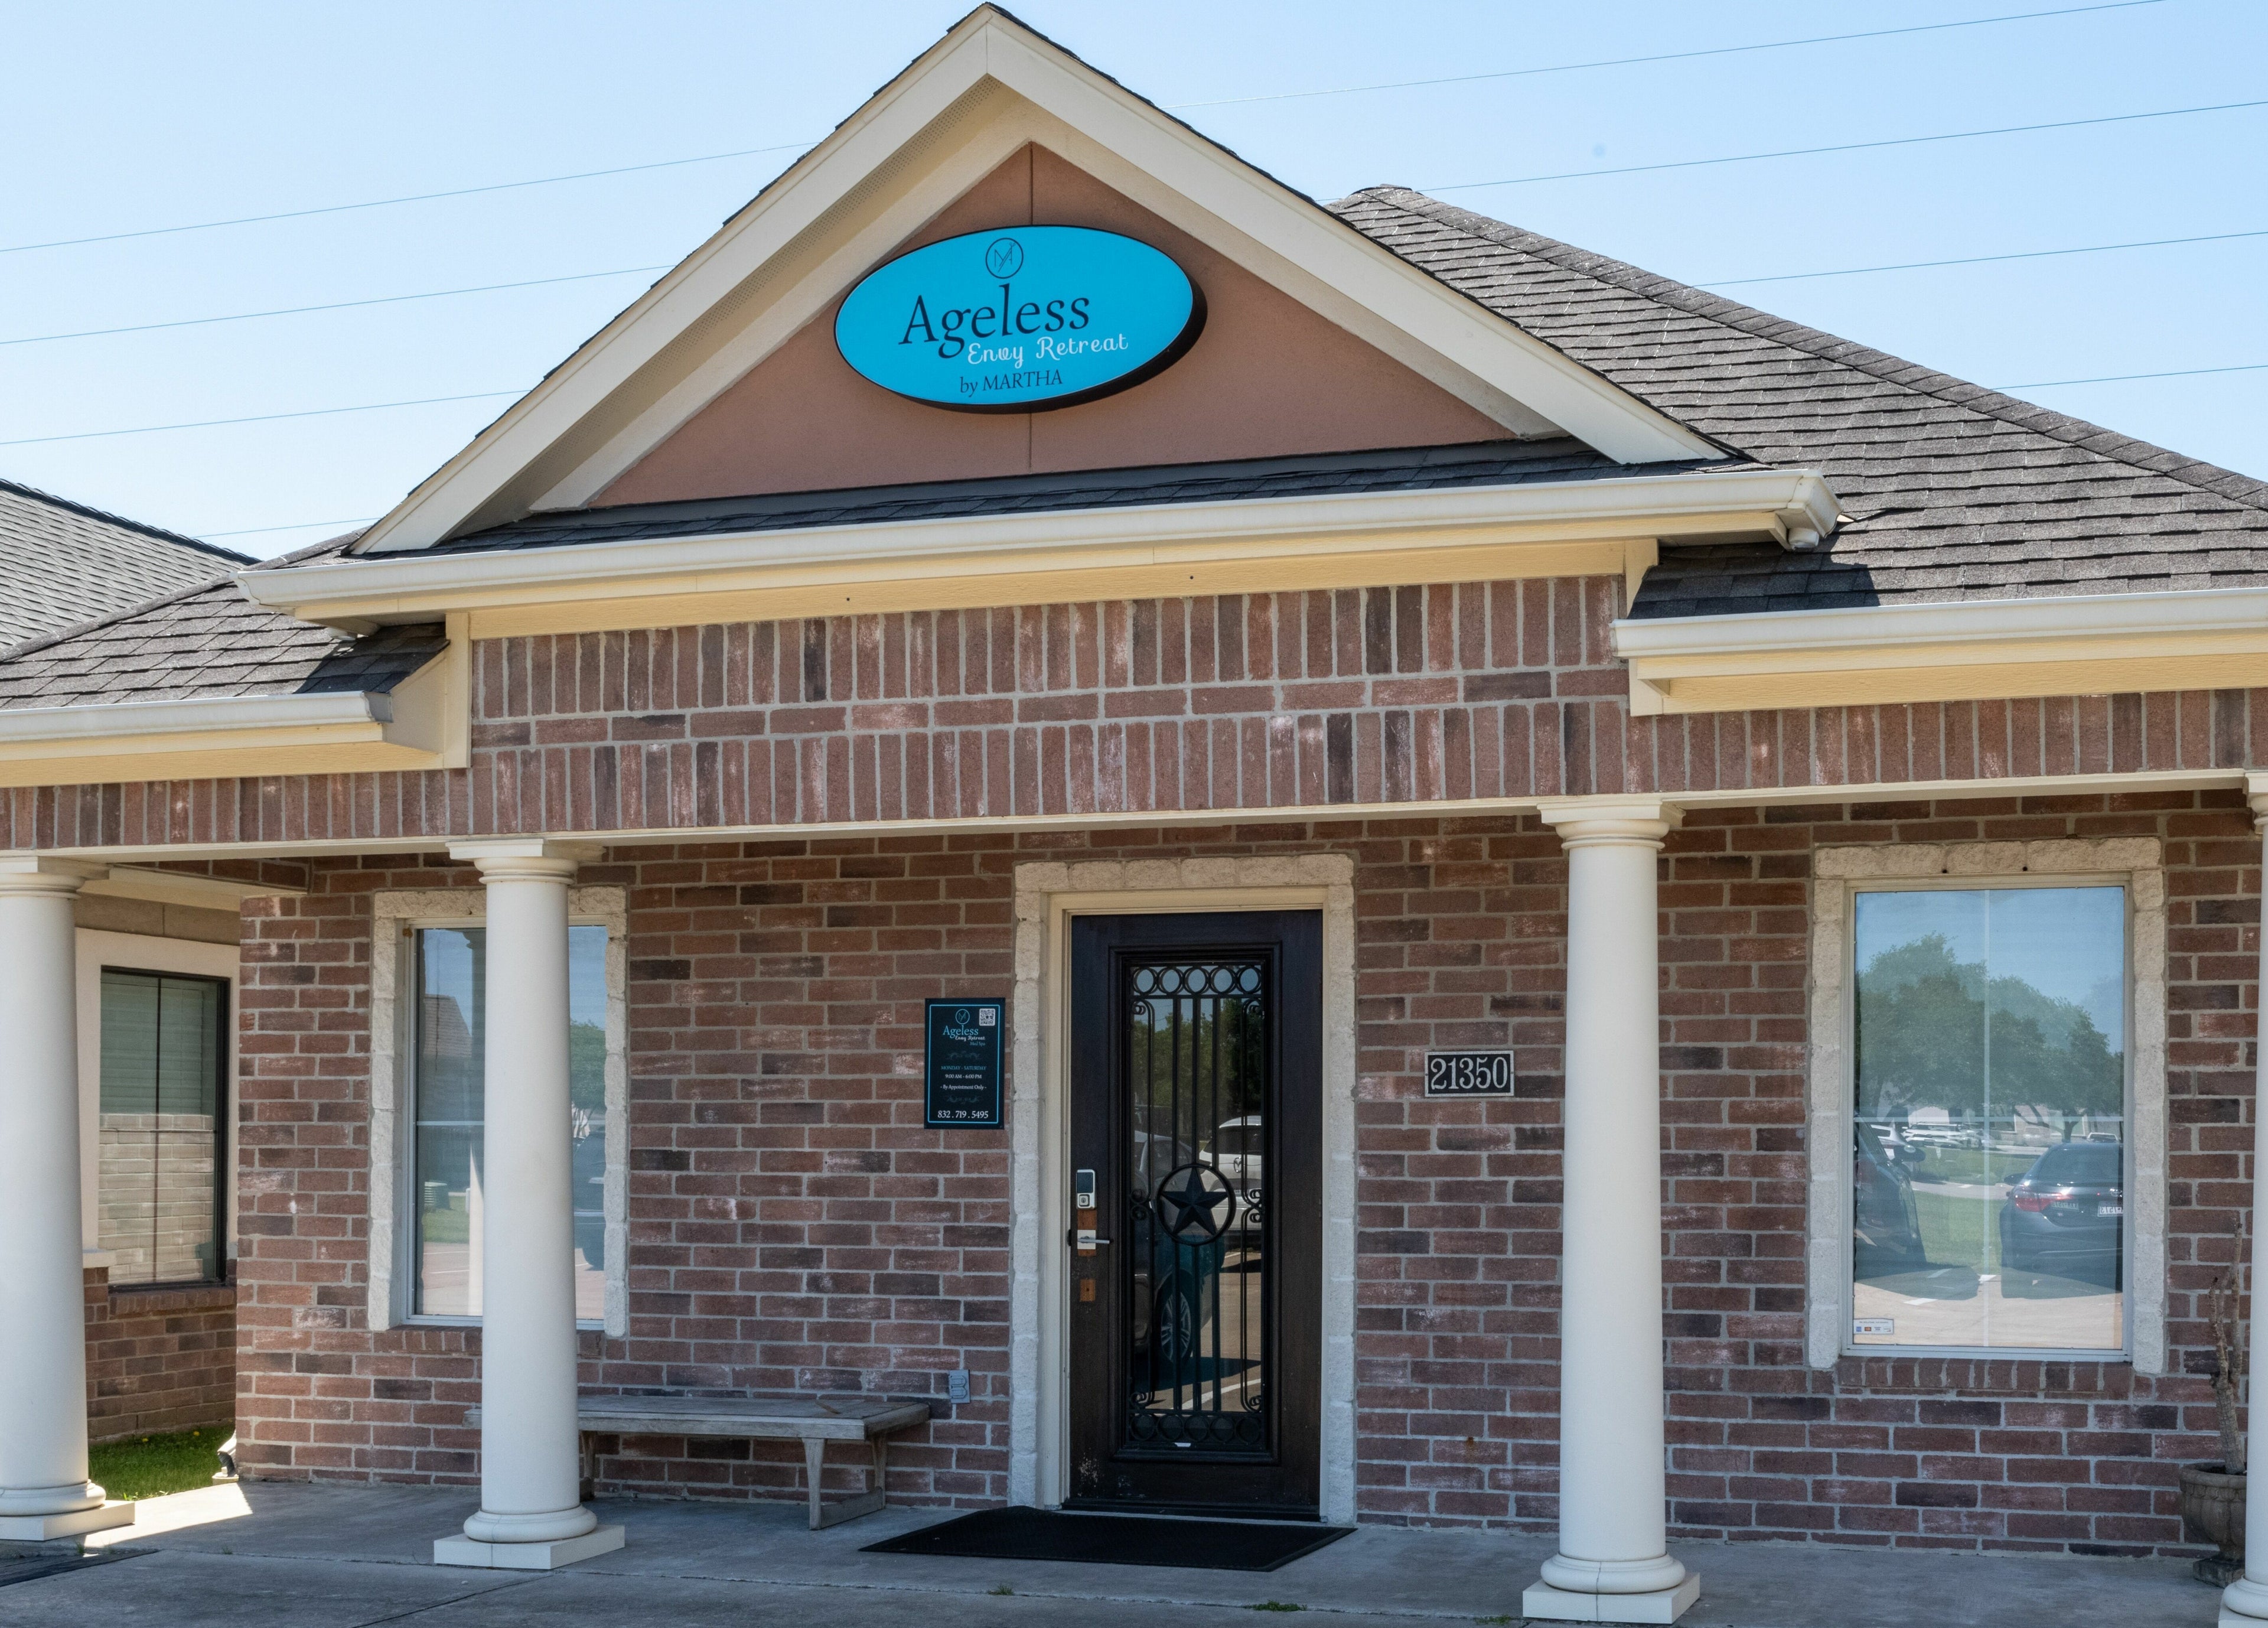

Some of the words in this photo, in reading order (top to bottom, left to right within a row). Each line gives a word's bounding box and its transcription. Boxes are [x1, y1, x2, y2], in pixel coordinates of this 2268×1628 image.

[898, 283, 1090, 359] Ageless
[967, 342, 1024, 369] Envy
[1036, 333, 1129, 361] Retreat
[959, 376, 978, 398] by
[982, 369, 1063, 392] MARTHA
[943, 1025, 979, 1038] Ageless
[1430, 1056, 1508, 1090] 21350
